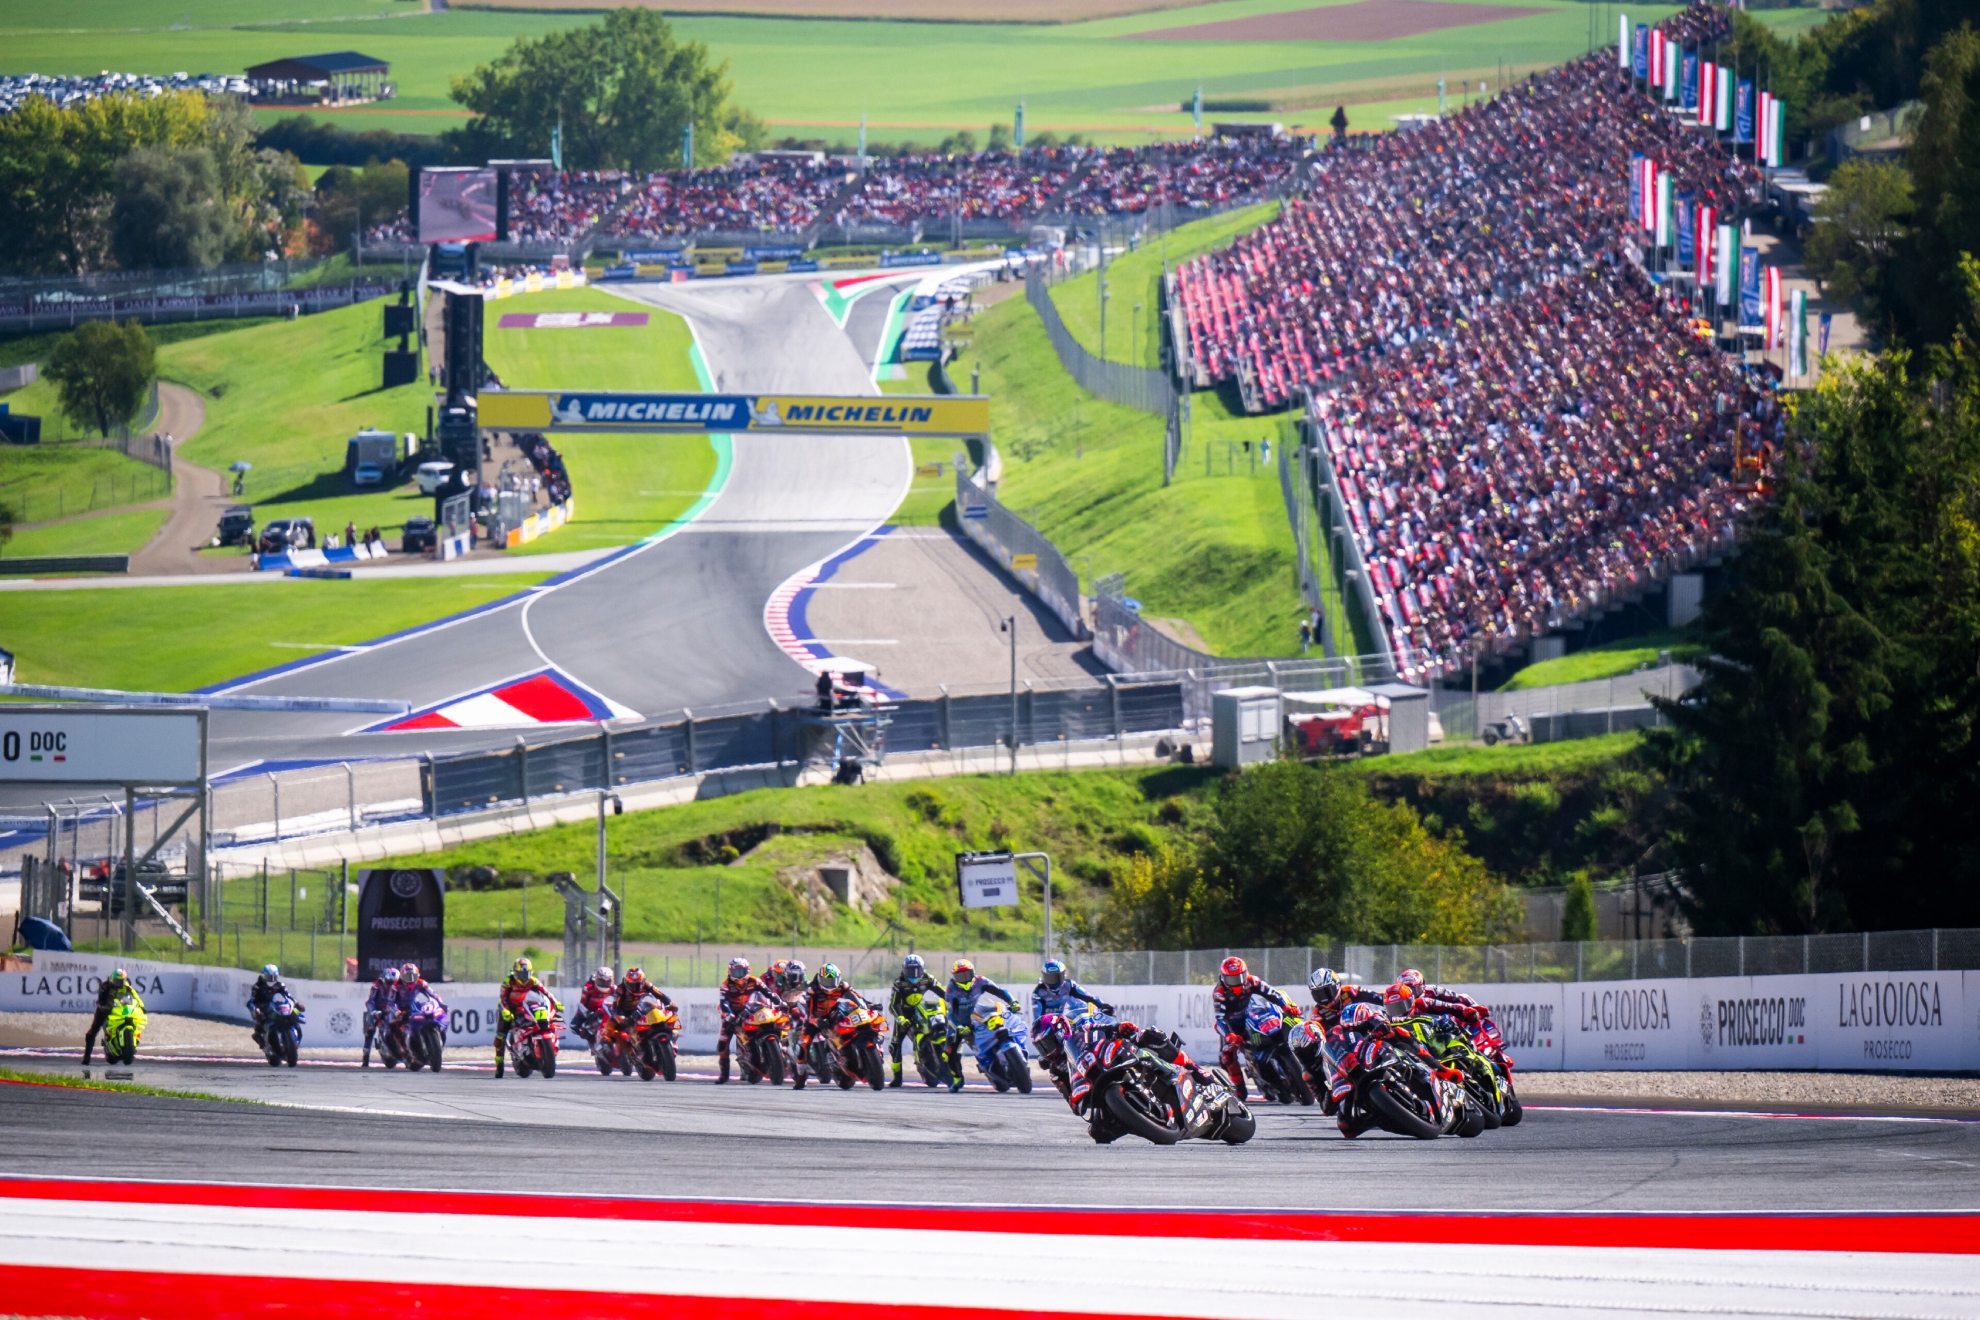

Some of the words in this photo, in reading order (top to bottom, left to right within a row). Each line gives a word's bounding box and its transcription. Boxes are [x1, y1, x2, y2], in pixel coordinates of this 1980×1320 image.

[587, 402, 736, 422] MICHELIN
[786, 405, 933, 423] MICHELIN
[30, 731, 67, 751] DOC
[371, 917, 421, 929] PROSECCO
[1580, 988, 1671, 1032] LAGIOIOSA
[1838, 981, 1943, 1028] LAGIOIOSA
[1717, 996, 1785, 1047] PROSECCO
[1788, 996, 1806, 1028] DOC
[1604, 1043, 1646, 1061] PROSECCO
[1863, 1040, 1913, 1060] PROSECCO
